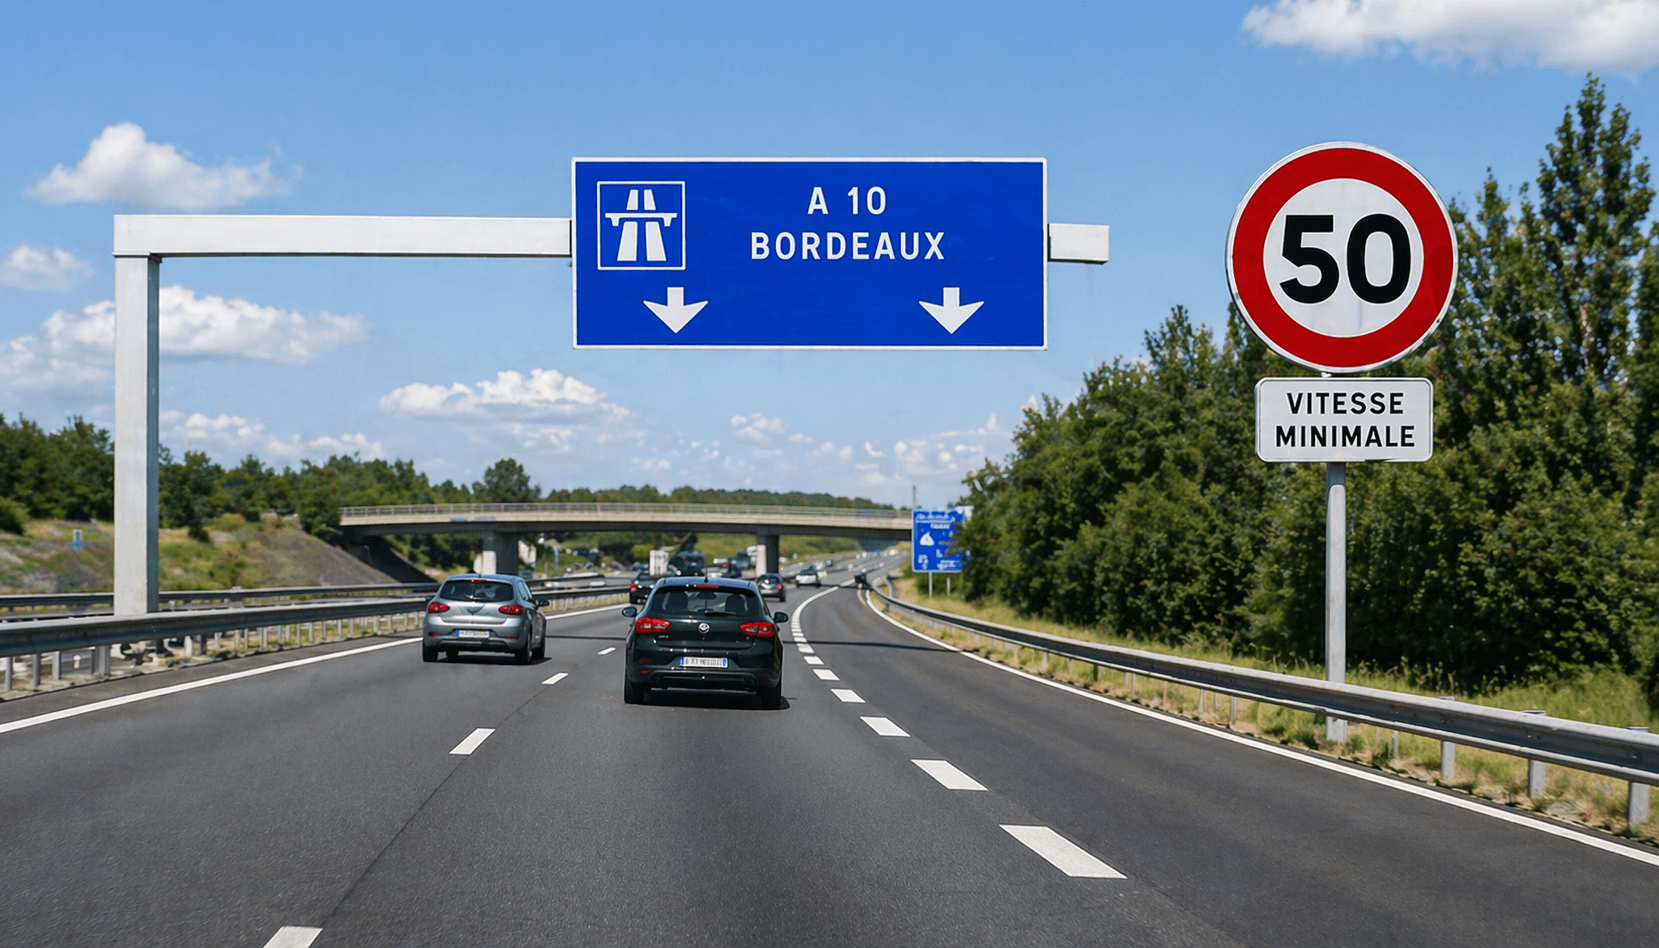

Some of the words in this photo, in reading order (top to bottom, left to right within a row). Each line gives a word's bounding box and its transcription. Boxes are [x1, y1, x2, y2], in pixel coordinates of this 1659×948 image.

[807, 186, 829, 215] A
[847, 186, 887, 215] 10
[751, 231, 945, 260] BORDEAUX
[1279, 213, 1412, 304] 50
[1286, 392, 1404, 415] VITESSE
[1276, 425, 1415, 448] MINIMALE
